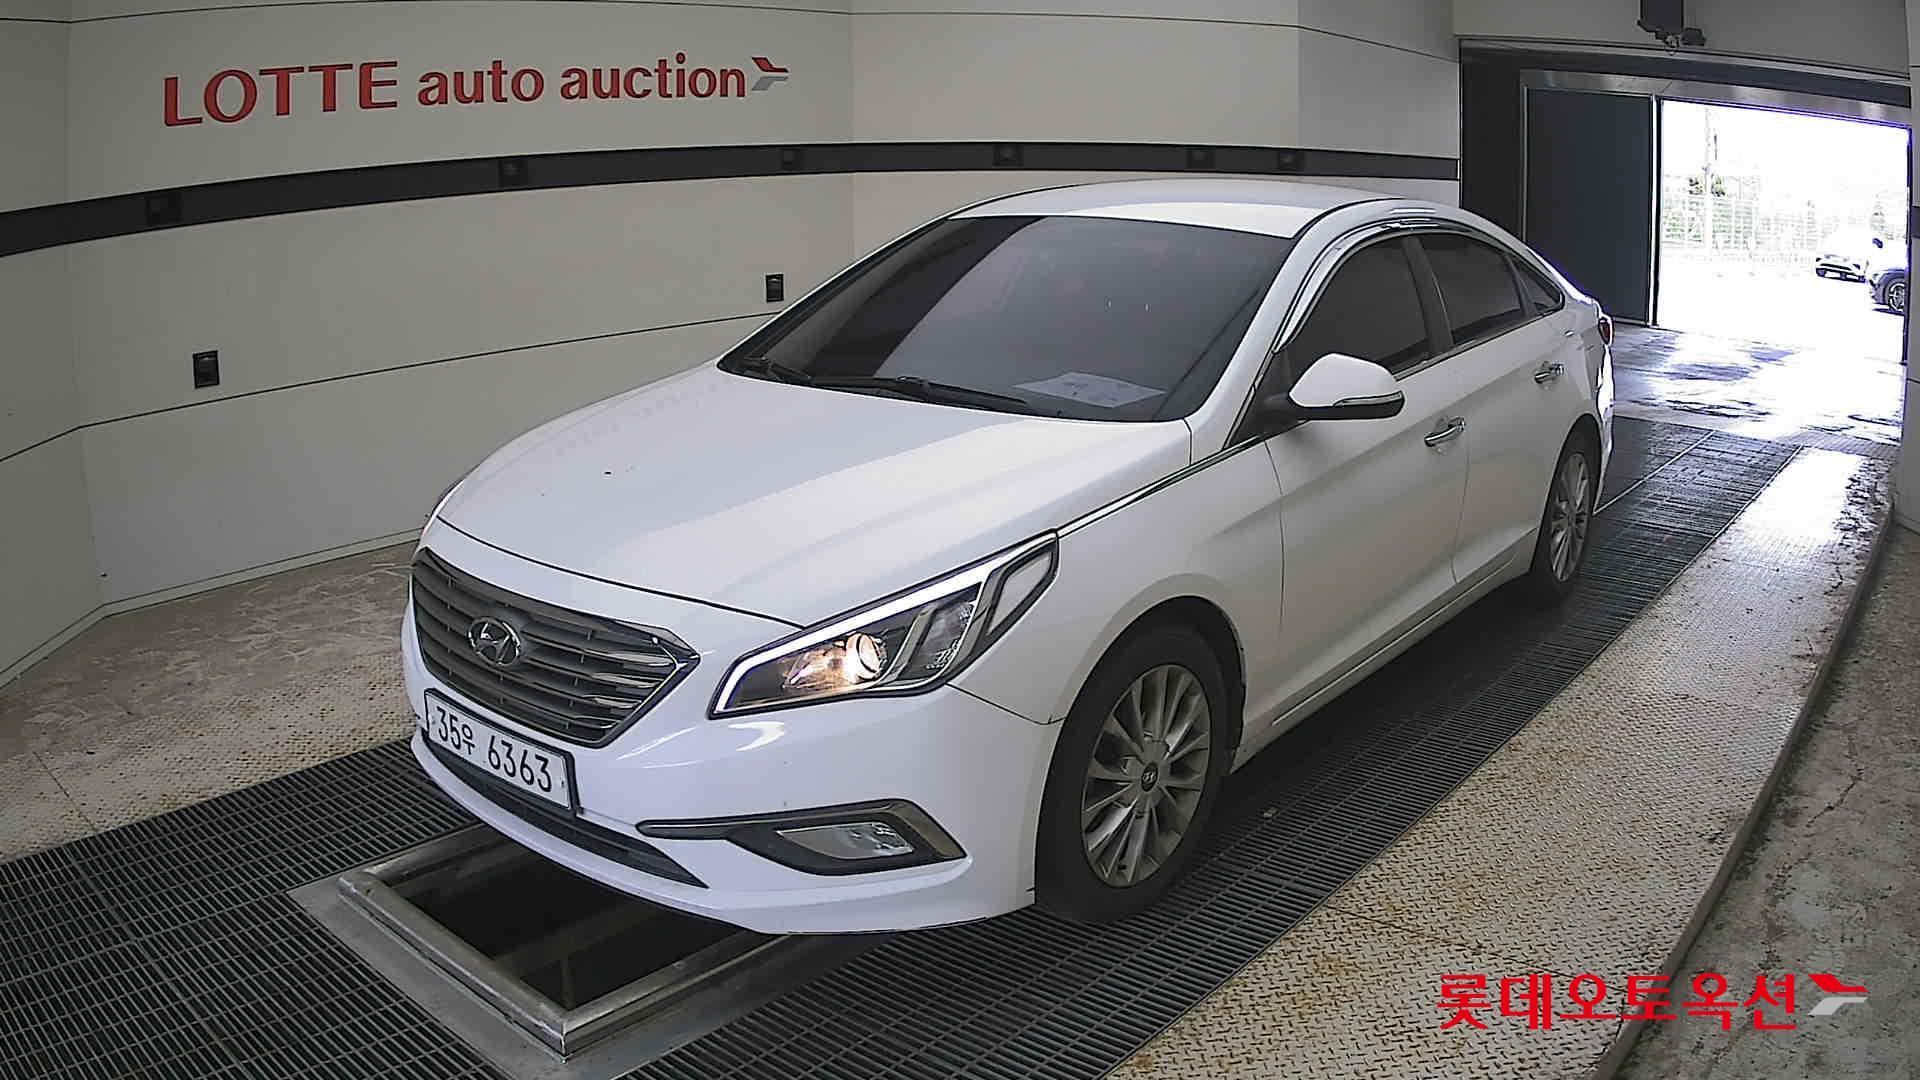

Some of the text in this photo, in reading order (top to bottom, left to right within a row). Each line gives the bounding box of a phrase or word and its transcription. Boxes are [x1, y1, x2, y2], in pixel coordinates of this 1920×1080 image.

[163, 52, 747, 127] LOTTE auto auction
[437, 706, 552, 793] 35우 6363
